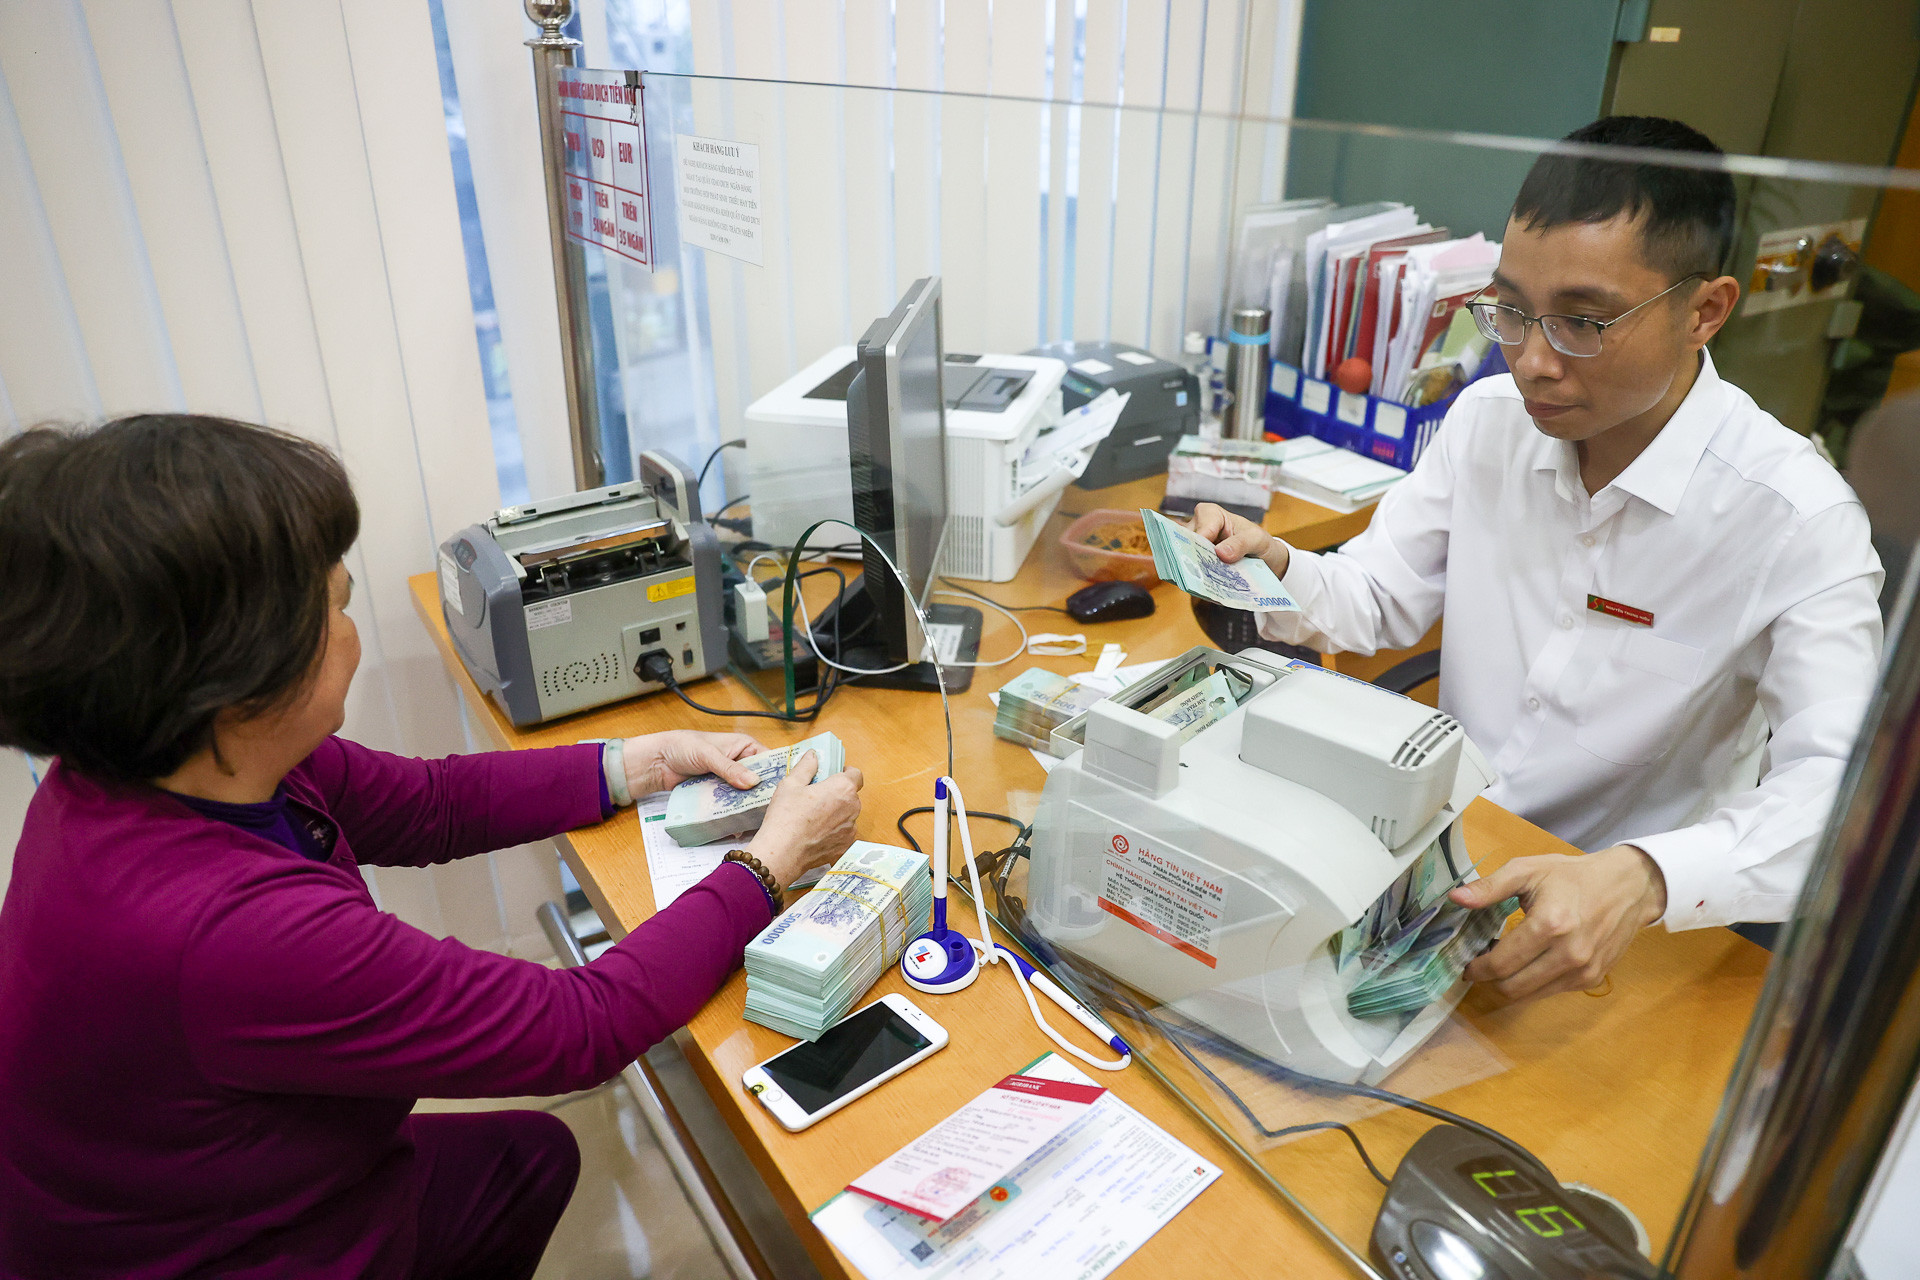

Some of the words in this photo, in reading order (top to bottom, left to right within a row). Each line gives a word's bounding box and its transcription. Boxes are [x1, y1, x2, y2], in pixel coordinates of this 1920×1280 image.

[592, 138, 605, 158] USD
[618, 142, 634, 163] EUR
[622, 201, 637, 222] TRÊN
[619, 229, 627, 245] 35
[1254, 597, 1291, 607] 500000
[1138, 847, 1163, 865] HÀNG
[1182, 869, 1201, 883] VIỆT
[1203, 880, 1223, 894] NAM
[1203, 909, 1218, 919] NAM
[761, 912, 802, 945] 500000
